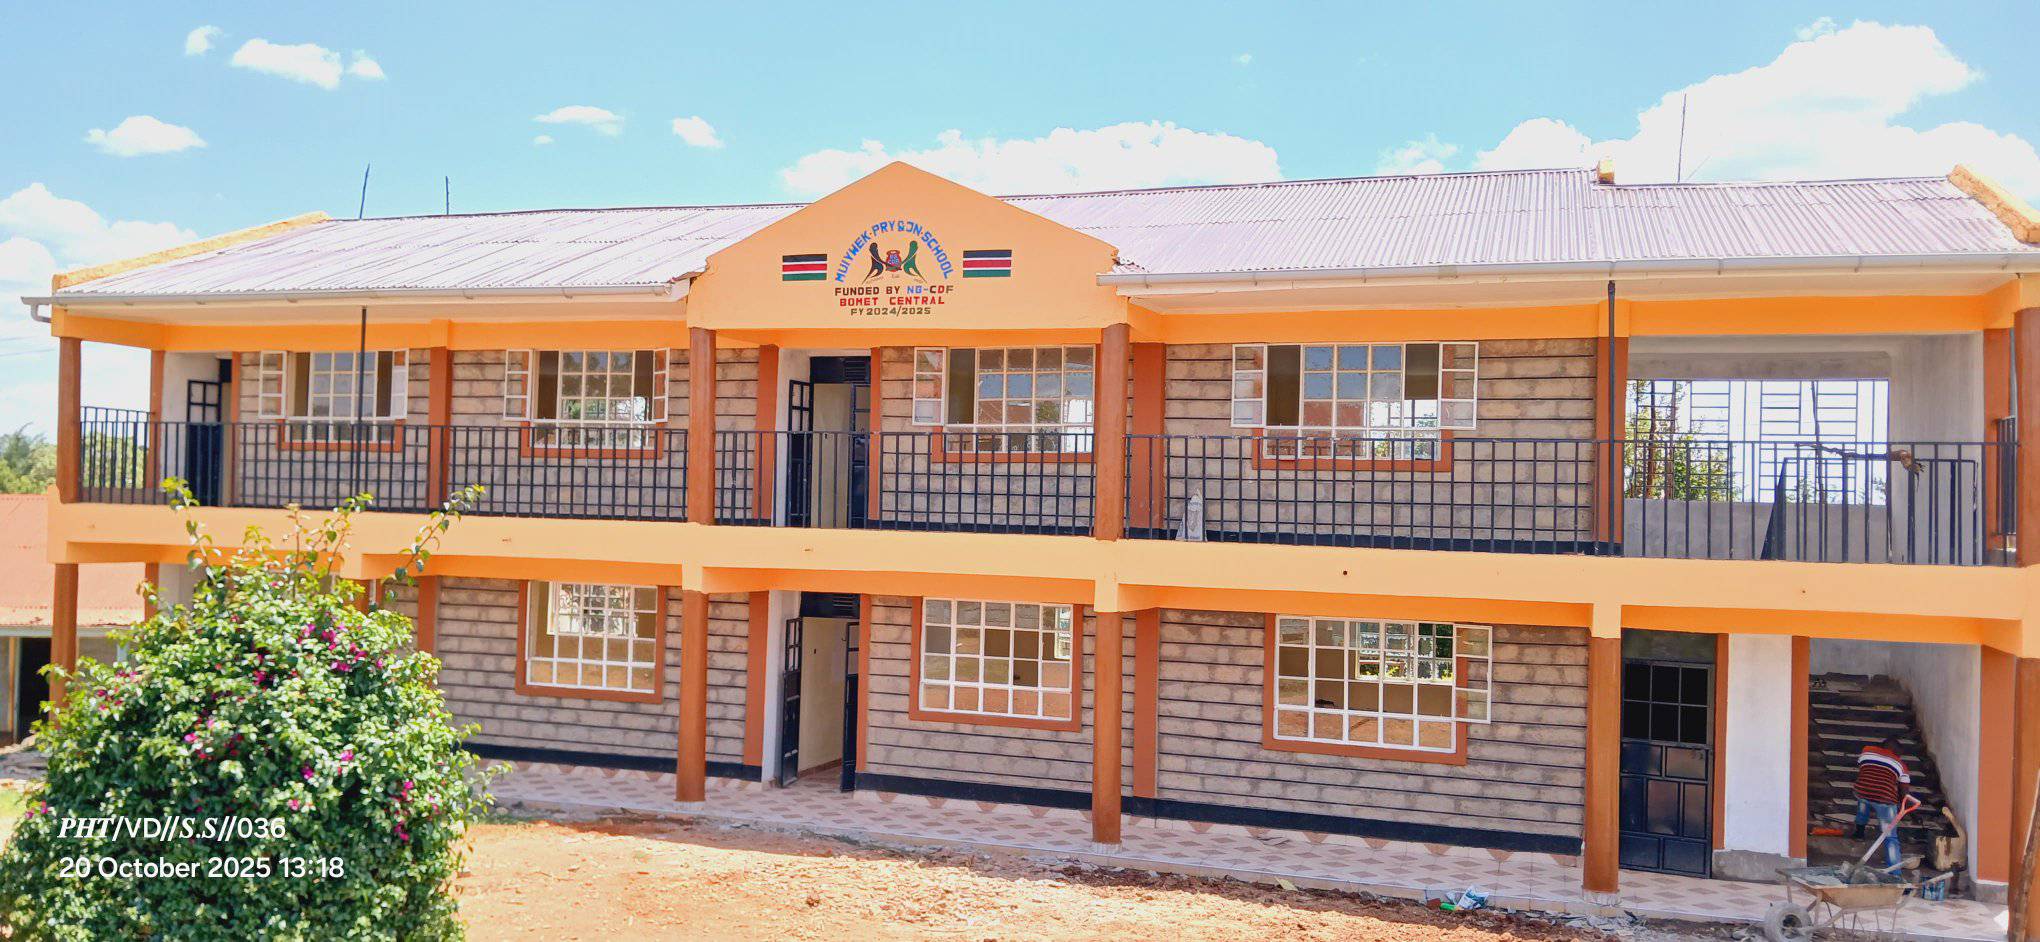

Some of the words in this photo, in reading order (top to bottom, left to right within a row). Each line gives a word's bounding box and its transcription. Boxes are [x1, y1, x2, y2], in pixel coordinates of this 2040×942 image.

[921, 231, 954, 279] SCHOOL
[835, 286, 880, 296] FUNDED
[886, 285, 900, 295] BY
[907, 285, 954, 294] NG-CDF
[840, 297, 879, 307] BOMET
[889, 296, 945, 306] CENTRAL
